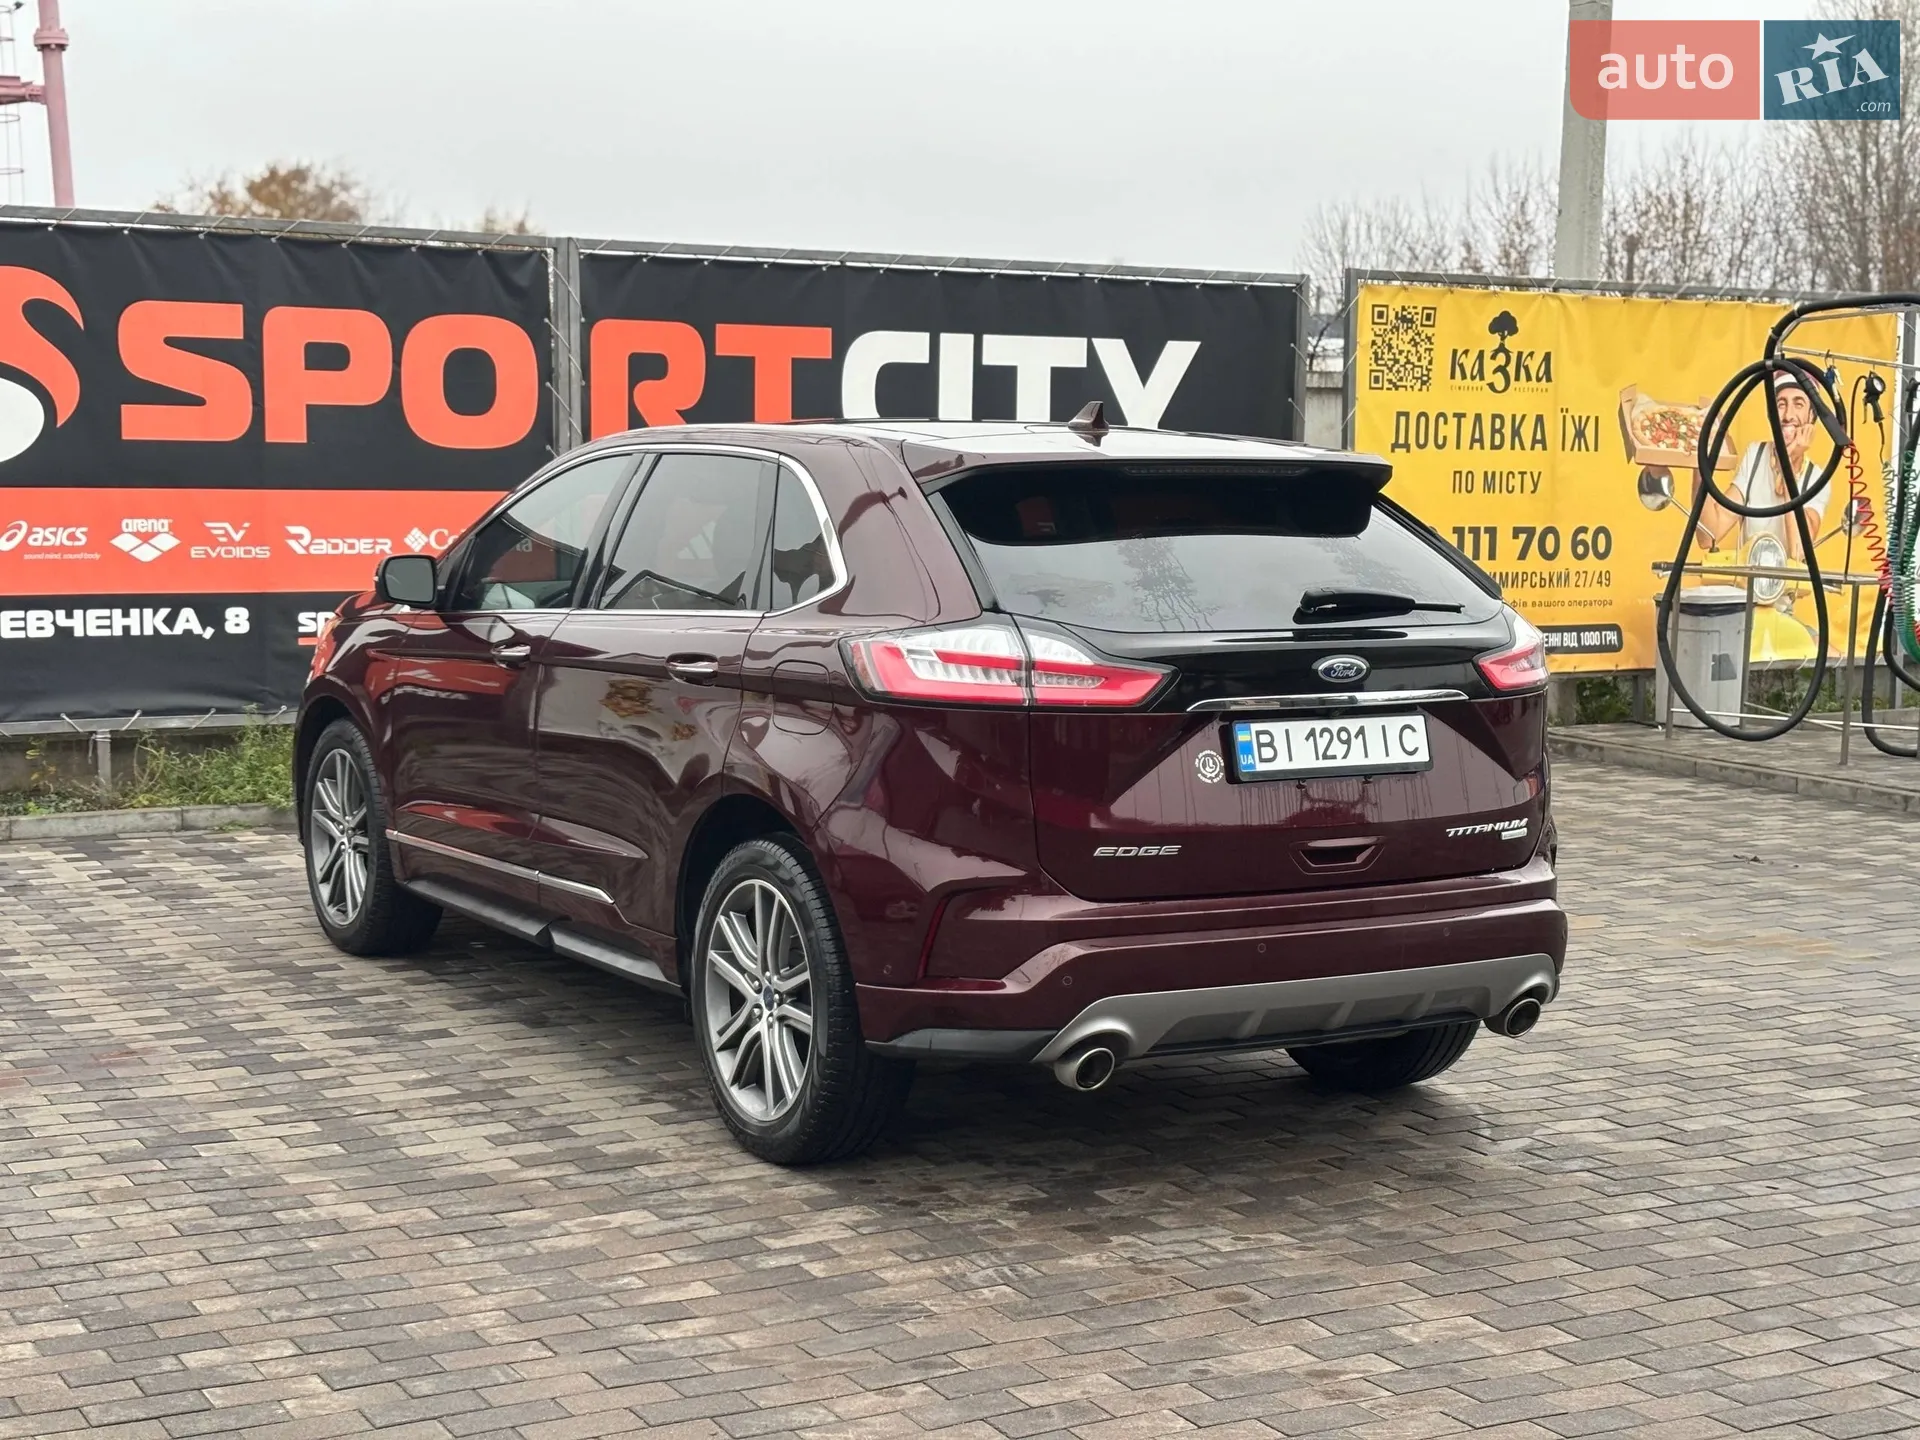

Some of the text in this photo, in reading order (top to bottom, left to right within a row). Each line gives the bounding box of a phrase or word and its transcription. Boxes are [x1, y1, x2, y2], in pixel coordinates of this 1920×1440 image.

[1391, 408, 1600, 453] ДОСТАВКА ЇЖІ
[1452, 470, 1542, 494] ПО МІСТУ
[121, 518, 170, 533] arena
[1512, 526, 1561, 561] 70
[1571, 525, 1612, 561] 60
[190, 546, 271, 559] EVOIDS
[1575, 570, 1612, 588] 27/49
[1531, 600, 1565, 608] вашого
[1568, 599, 1613, 609] оператора
[224, 607, 250, 634] 8
[1563, 632, 1578, 648] ВІД
[1580, 631, 1601, 646] 1000
[1331, 663, 1357, 679] Ford
[1255, 723, 1420, 763] BI 1291 IC
[1240, 754, 1255, 765] UA
[1446, 817, 1528, 838] TITANIUM
[1093, 845, 1182, 857] EDGE
